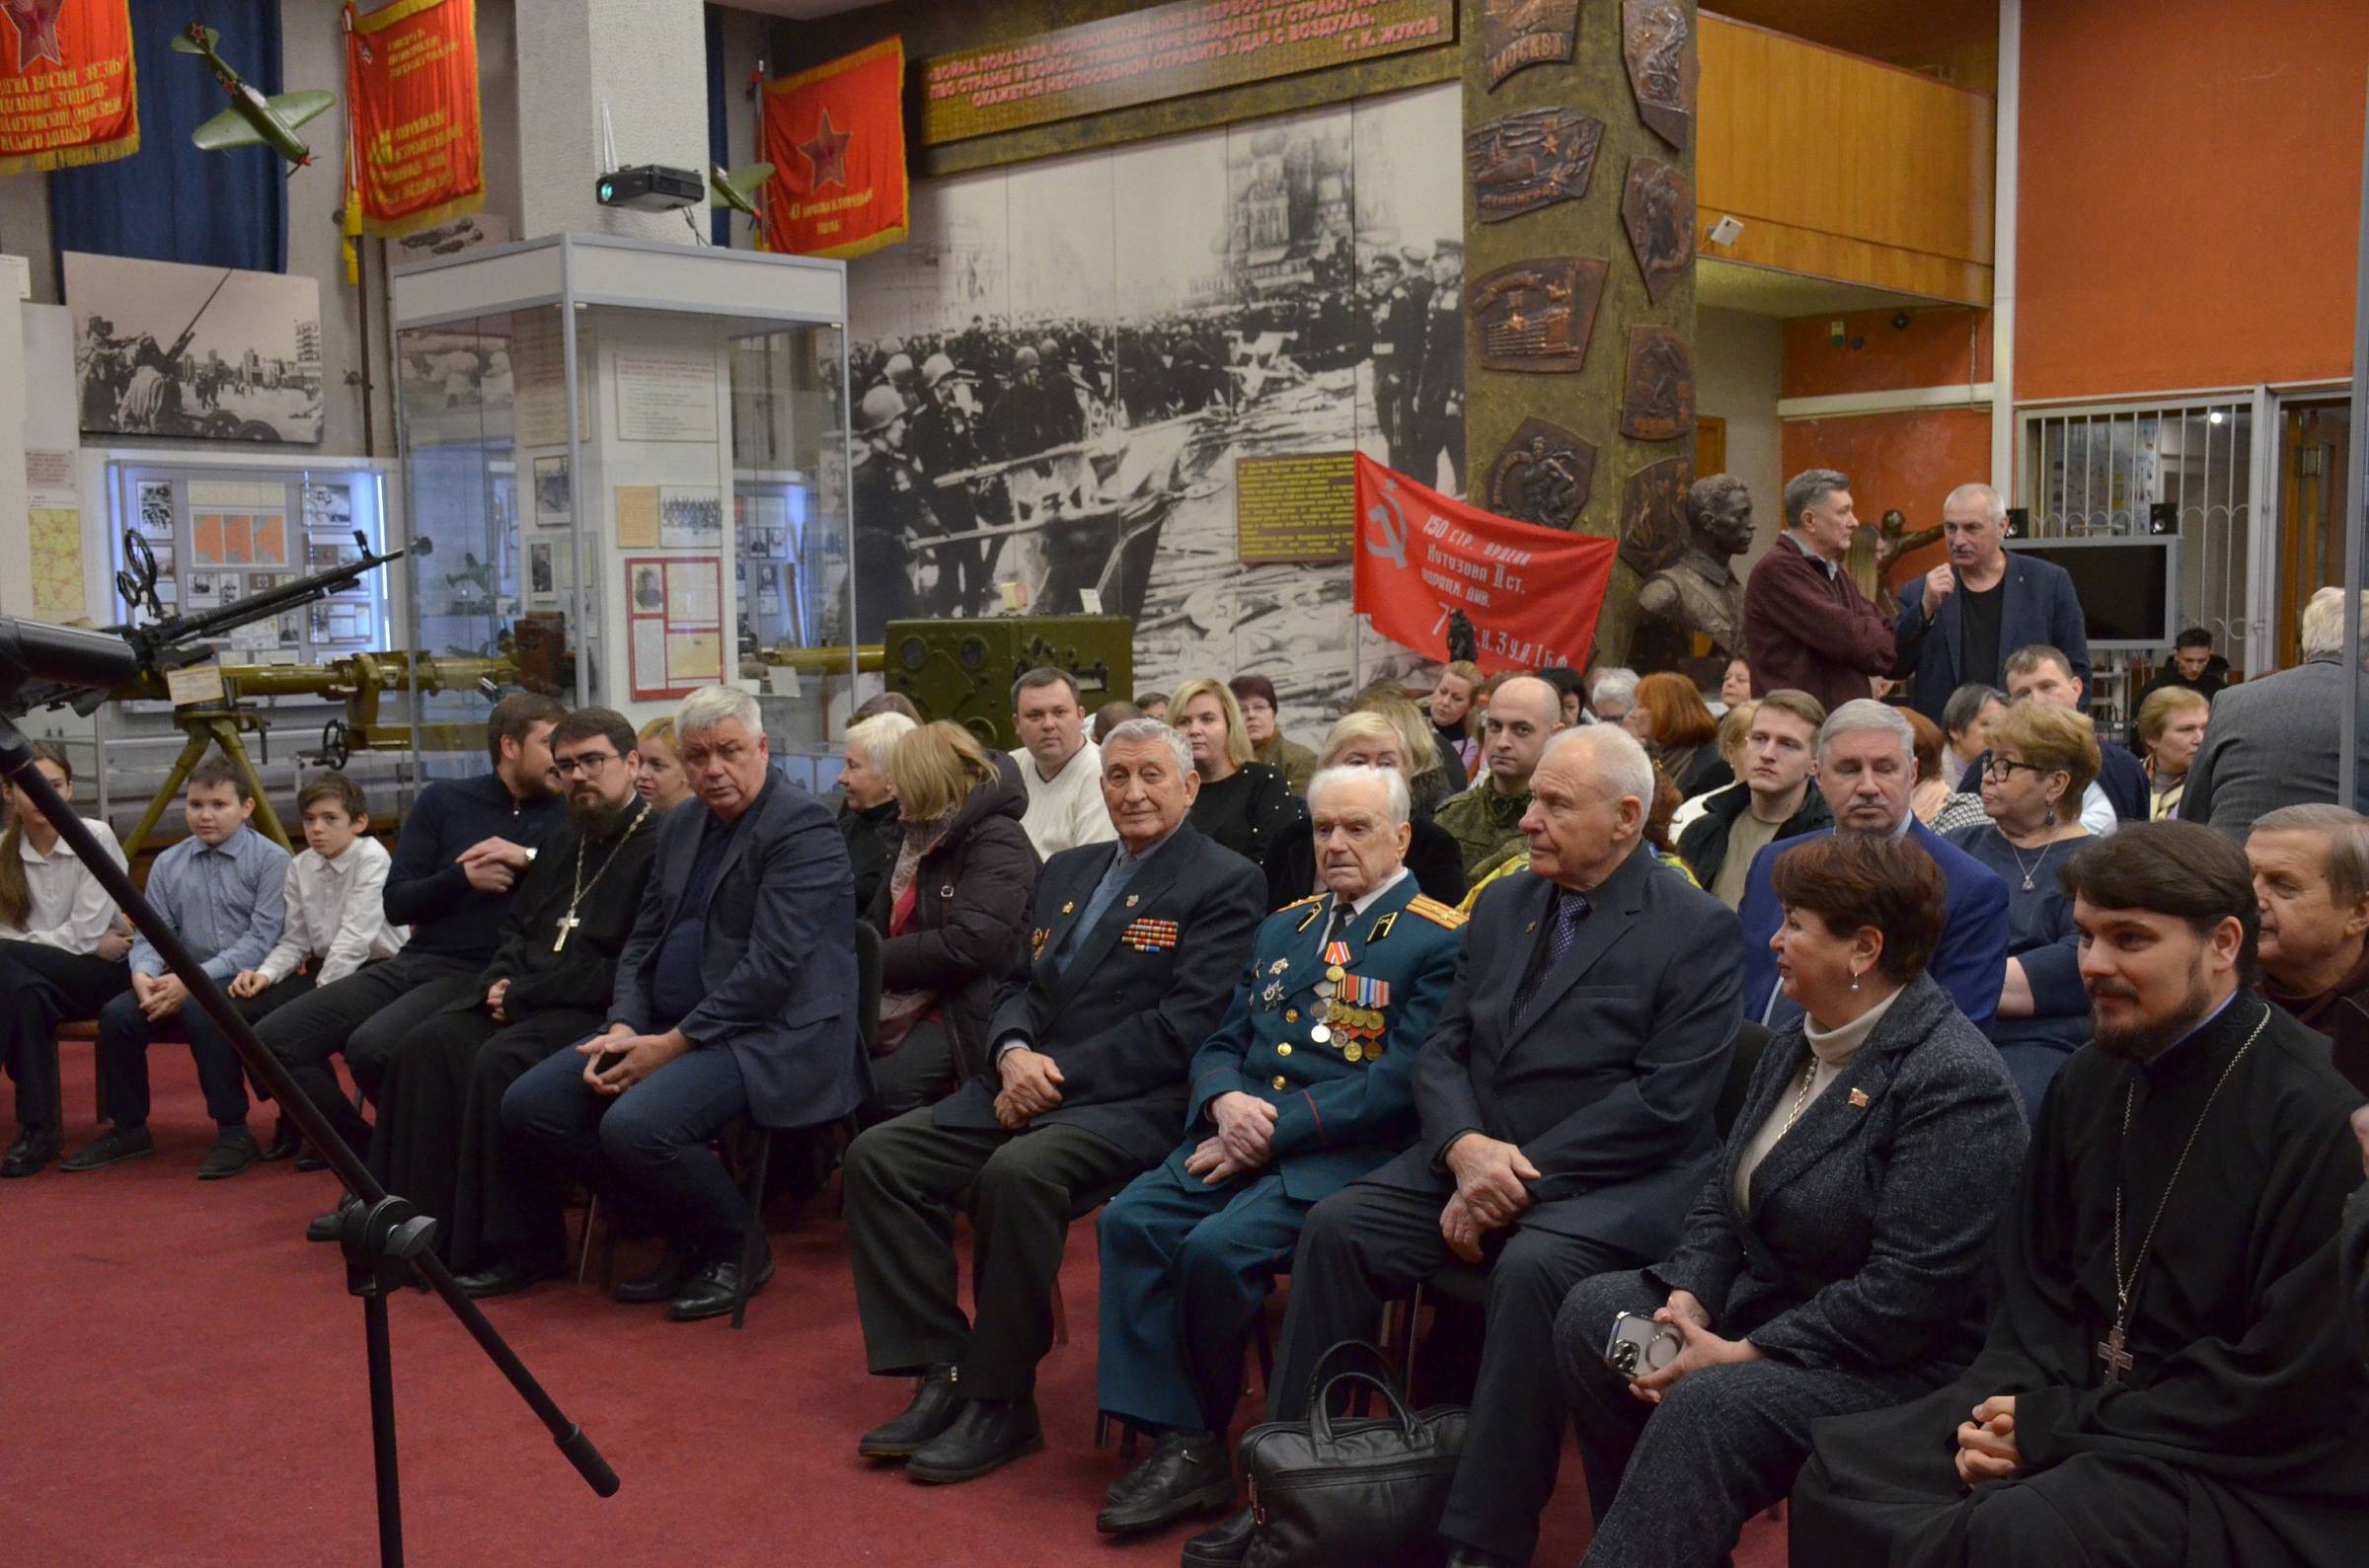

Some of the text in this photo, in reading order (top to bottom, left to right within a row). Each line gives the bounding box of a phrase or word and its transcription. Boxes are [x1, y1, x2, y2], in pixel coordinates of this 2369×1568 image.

[1232, 30, 1269, 55] УДАР
[1380, 15, 1440, 44] ЖУКОВ
[1491, 32, 1565, 79] МОСКВА
[1423, 515, 1449, 538] 150
